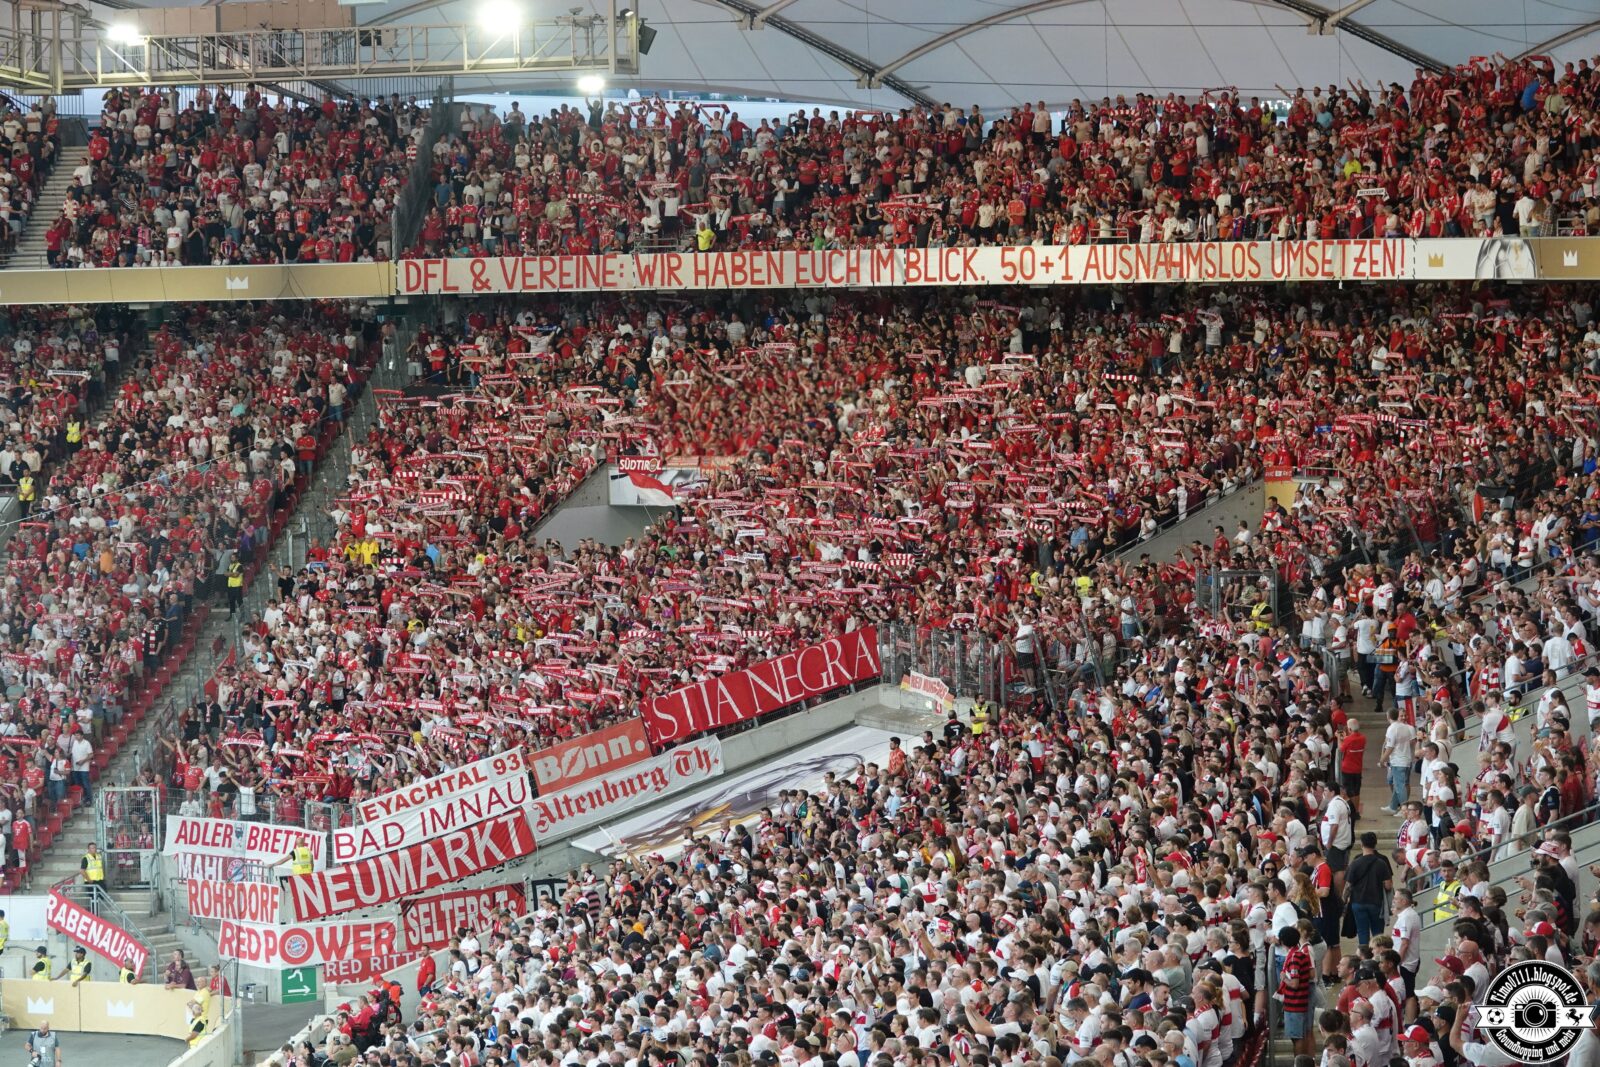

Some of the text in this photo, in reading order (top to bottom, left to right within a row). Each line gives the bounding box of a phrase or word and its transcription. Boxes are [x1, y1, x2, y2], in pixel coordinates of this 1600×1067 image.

[404, 238, 1405, 292] DFL & VEREINE: WIR HABEN EUCH IM BLICK. 50+1 AUSNAHMSLOS UMSETZEN!
[742, 631, 880, 714] NEGRA
[361, 753, 521, 823] EYACHTAL 93
[174, 819, 233, 849] ADLER
[334, 777, 527, 860] BAD IMNAU
[290, 811, 523, 919] NEUMARKT
[187, 878, 280, 924] ROHRDORF
[218, 920, 397, 965] RED POWER
[325, 958, 363, 977] RED
